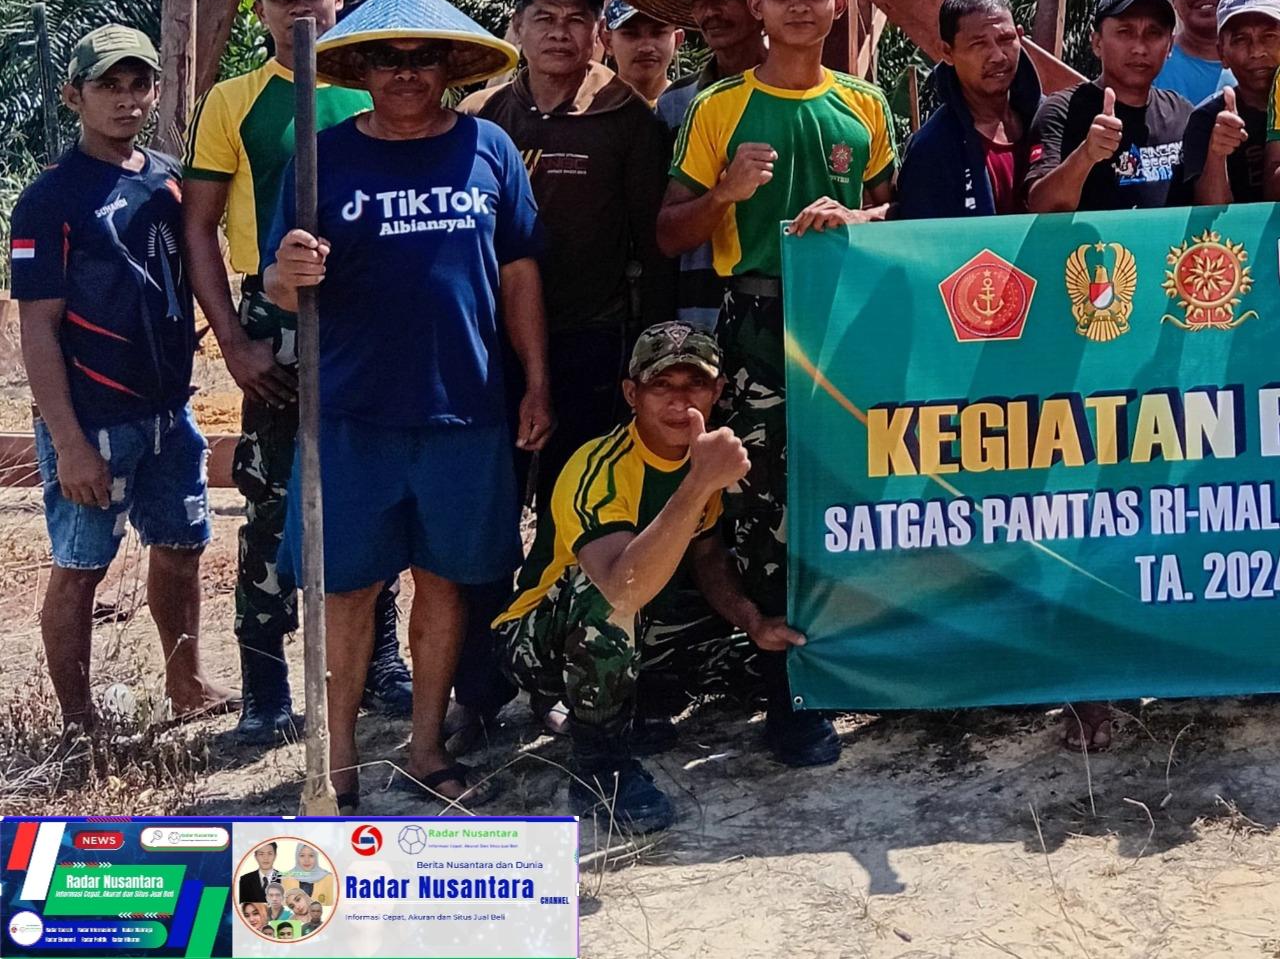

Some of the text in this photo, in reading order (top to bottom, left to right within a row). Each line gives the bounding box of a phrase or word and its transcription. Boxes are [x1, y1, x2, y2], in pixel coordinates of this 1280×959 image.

[376, 187, 489, 218] TikTok
[379, 215, 475, 236] Albiansyah
[867, 390, 1236, 477] KEGIATAN
[824, 500, 971, 553] SATGAS
[983, 489, 1139, 544] PAMTAS
[1135, 554, 1193, 603] TA.
